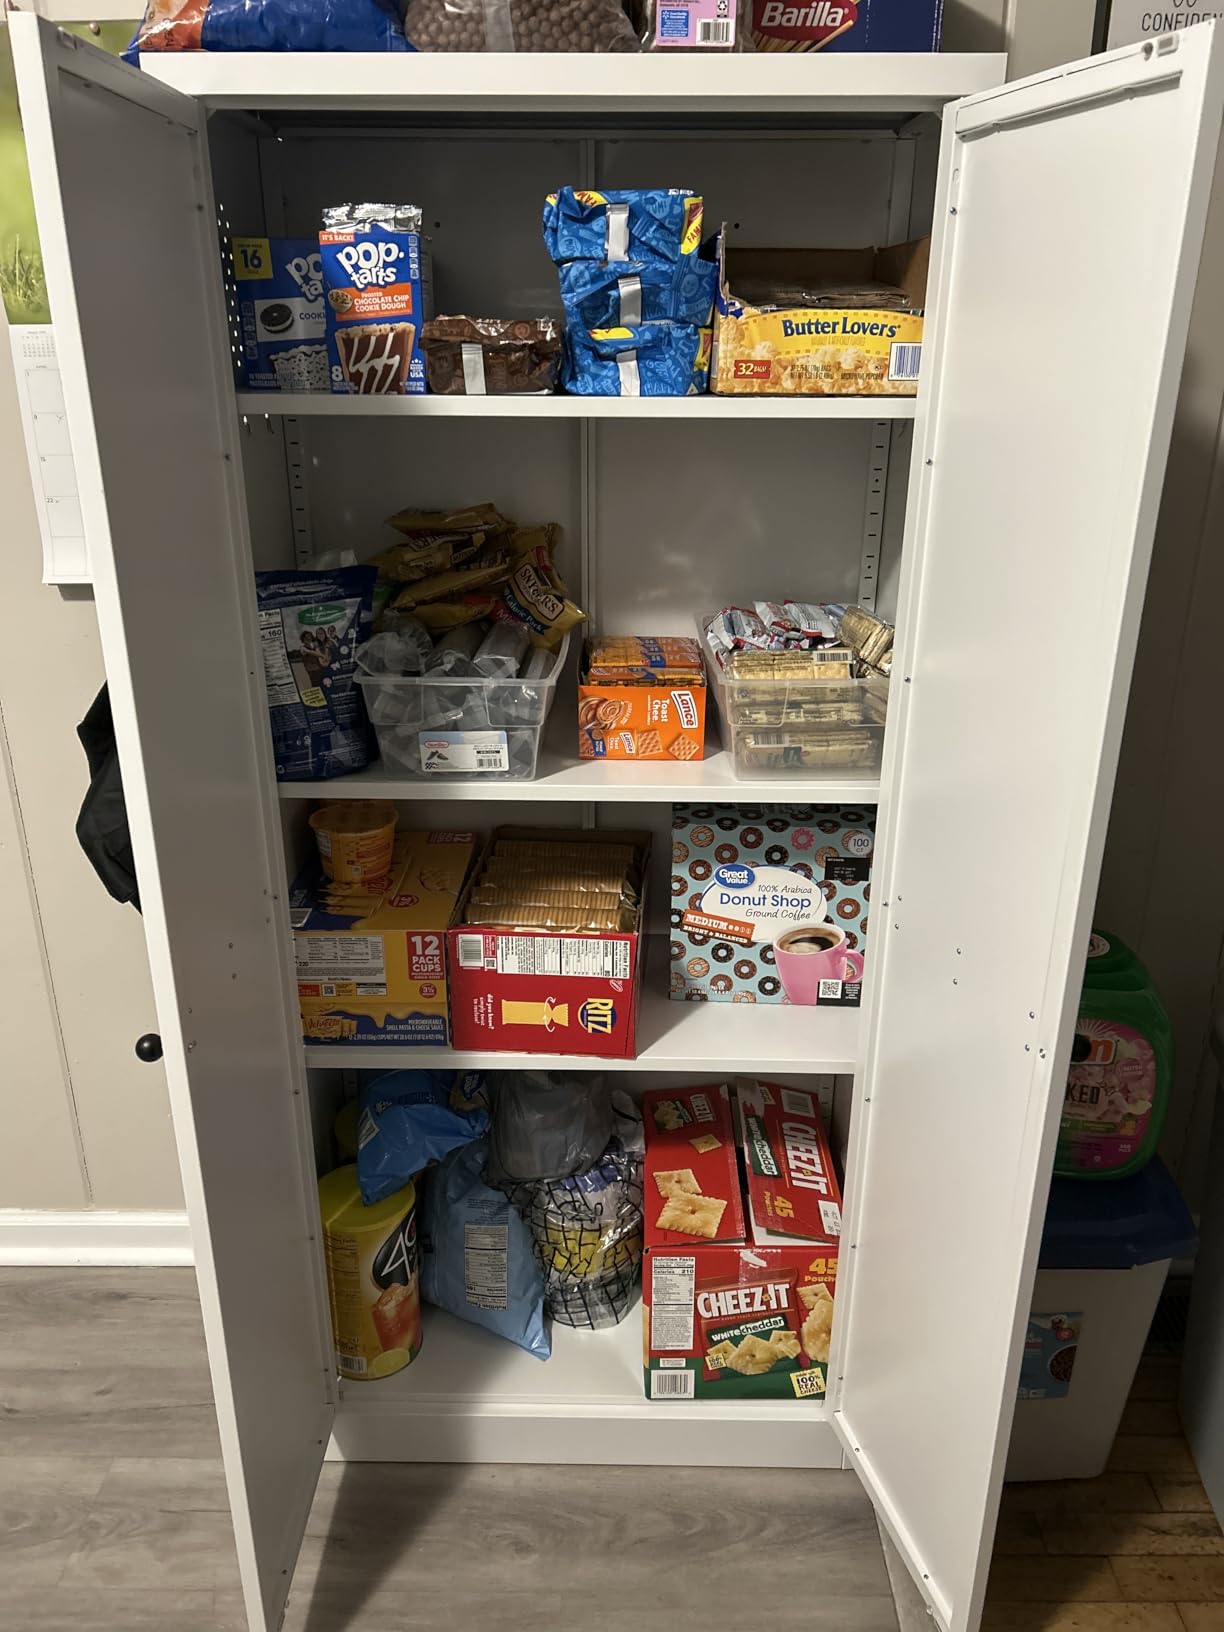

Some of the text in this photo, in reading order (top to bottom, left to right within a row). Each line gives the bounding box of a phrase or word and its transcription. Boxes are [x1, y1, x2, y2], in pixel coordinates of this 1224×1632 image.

[761, 2, 843, 28] Barilla
[1142, 13, 1223, 32] CONFID
[334, 233, 353, 241] BACK!
[240, 249, 262, 269] 16
[286, 253, 322, 283] po
[351, 267, 397, 288] tarts
[354, 294, 409, 305] CHOCOLATE CHIP
[355, 302, 406, 312] COOKIE DOUGH
[299, 312, 326, 321] COOK
[782, 317, 898, 338] Butter Lovers
[332, 365, 343, 381] 8
[737, 363, 754, 375] 32
[652, 699, 661, 721] Chee
[661, 699, 670, 722] Toast
[677, 693, 694, 727] Lance
[623, 734, 633, 752] Lance
[853, 838, 869, 847] 100
[719, 868, 749, 879] Great
[725, 877, 749, 885] Value
[758, 885, 813, 894] 100% Arabica
[720, 893, 811, 910] Donut Shop
[686, 914, 728, 930] MEDIUM
[745, 908, 811, 920] Ground Coffee
[683, 925, 708, 935] BRIGHT
[714, 932, 748, 944] BALANCED
[411, 935, 440, 955] 12
[412, 956, 440, 964] PACK
[413, 964, 441, 972] CUPS
[586, 998, 614, 1034] RITZ
[1065, 1083, 1100, 1104] KED
[753, 1139, 778, 1176] cheddar
[774, 1196, 795, 1218] 45
[809, 1258, 838, 1275] 45
[711, 1316, 785, 1341] WHITE cheddar
[797, 1374, 820, 1385] 100%
[799, 1381, 820, 1391] REAL
